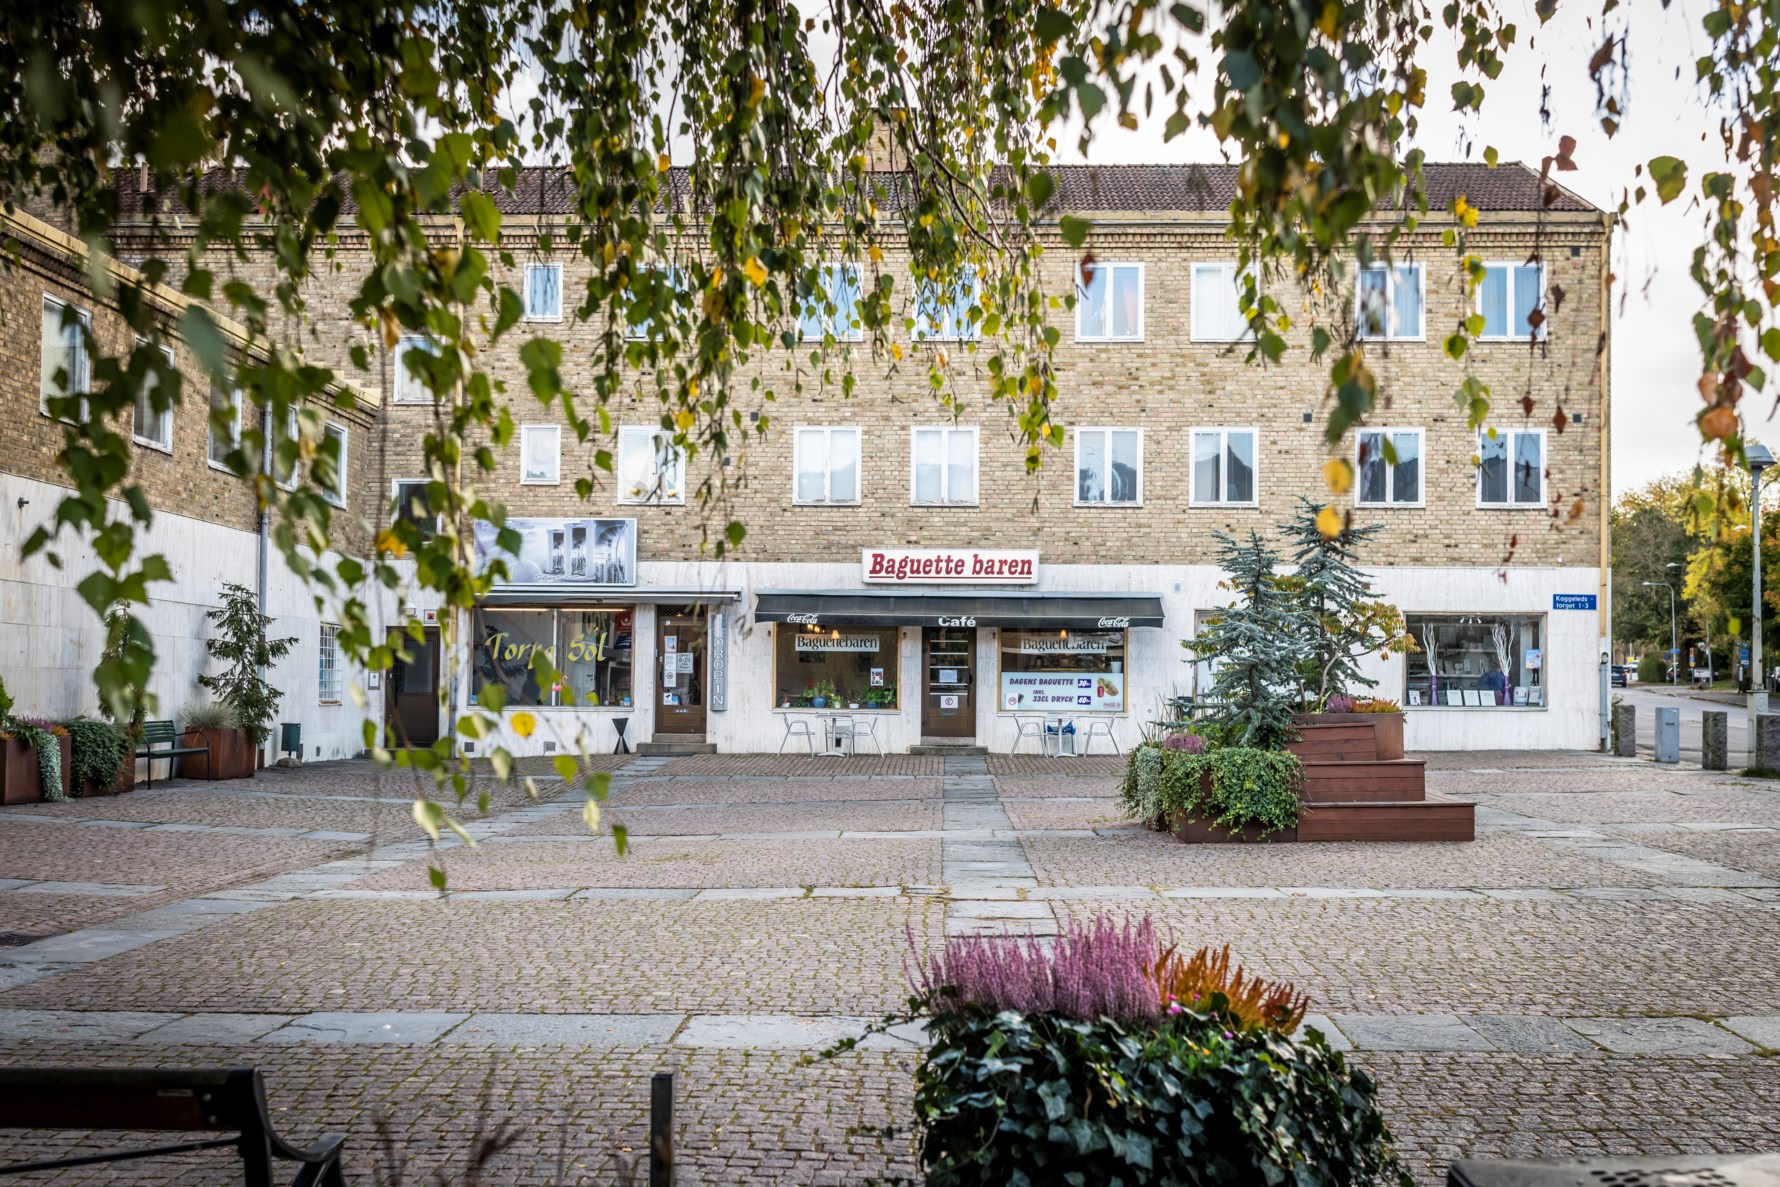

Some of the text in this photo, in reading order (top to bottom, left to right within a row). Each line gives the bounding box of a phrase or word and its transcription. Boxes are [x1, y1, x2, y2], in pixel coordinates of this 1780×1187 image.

[868, 552, 1033, 580] Baguette baren
[937, 615, 977, 628] Café
[567, 631, 608, 662] Sol
[713, 638, 724, 679] DROP
[1009, 678, 1036, 686] DAGENS
[1039, 678, 1074, 686] BAGUETTE
[1032, 695, 1049, 703] 33CL
[1051, 695, 1074, 703] DRYCK
